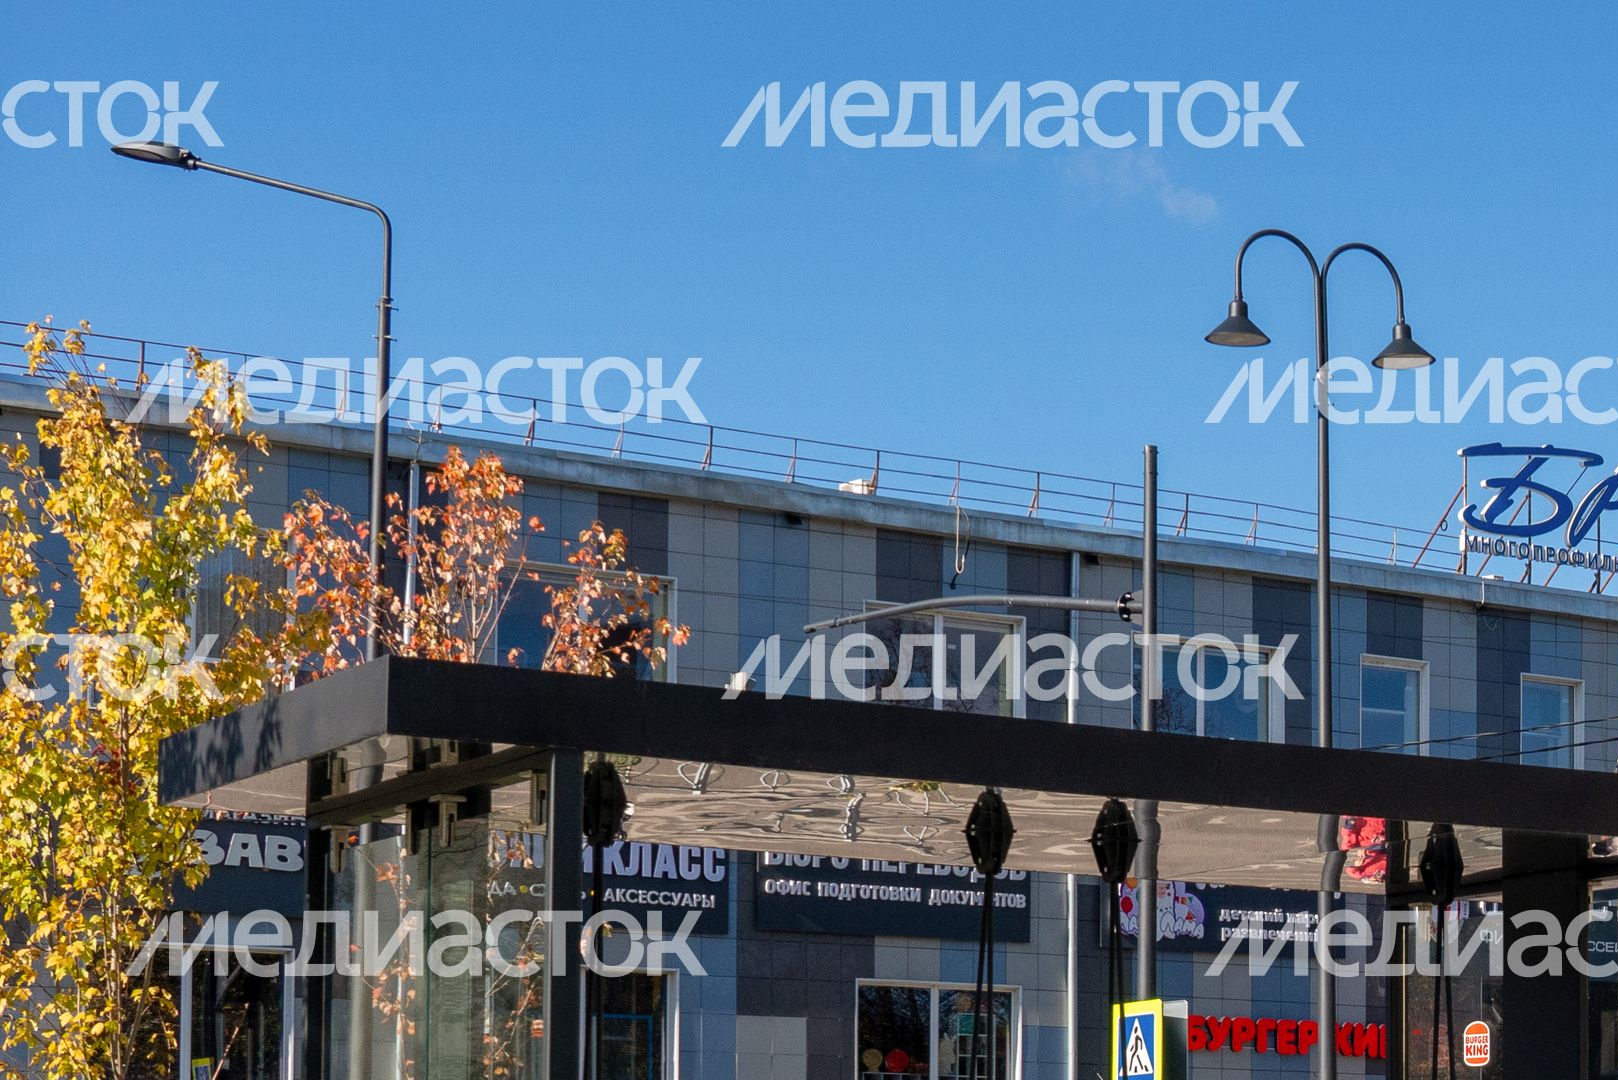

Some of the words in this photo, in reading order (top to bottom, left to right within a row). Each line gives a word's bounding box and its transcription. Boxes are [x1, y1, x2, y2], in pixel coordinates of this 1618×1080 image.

[603, 841, 726, 882] КЛАСС
[603, 887, 716, 909] АКСЕССУАРЫ
[764, 878, 811, 896] ОФИС
[817, 881, 921, 901] ПОДГОТОВКИ
[929, 887, 1027, 908] ДОКУМНТОВ
[1219, 908, 1284, 923] детский
[1188, 1014, 1318, 1056] БУРГЕР
[1465, 1036, 1489, 1044] BURGER
[1465, 1045, 1489, 1056] KING
